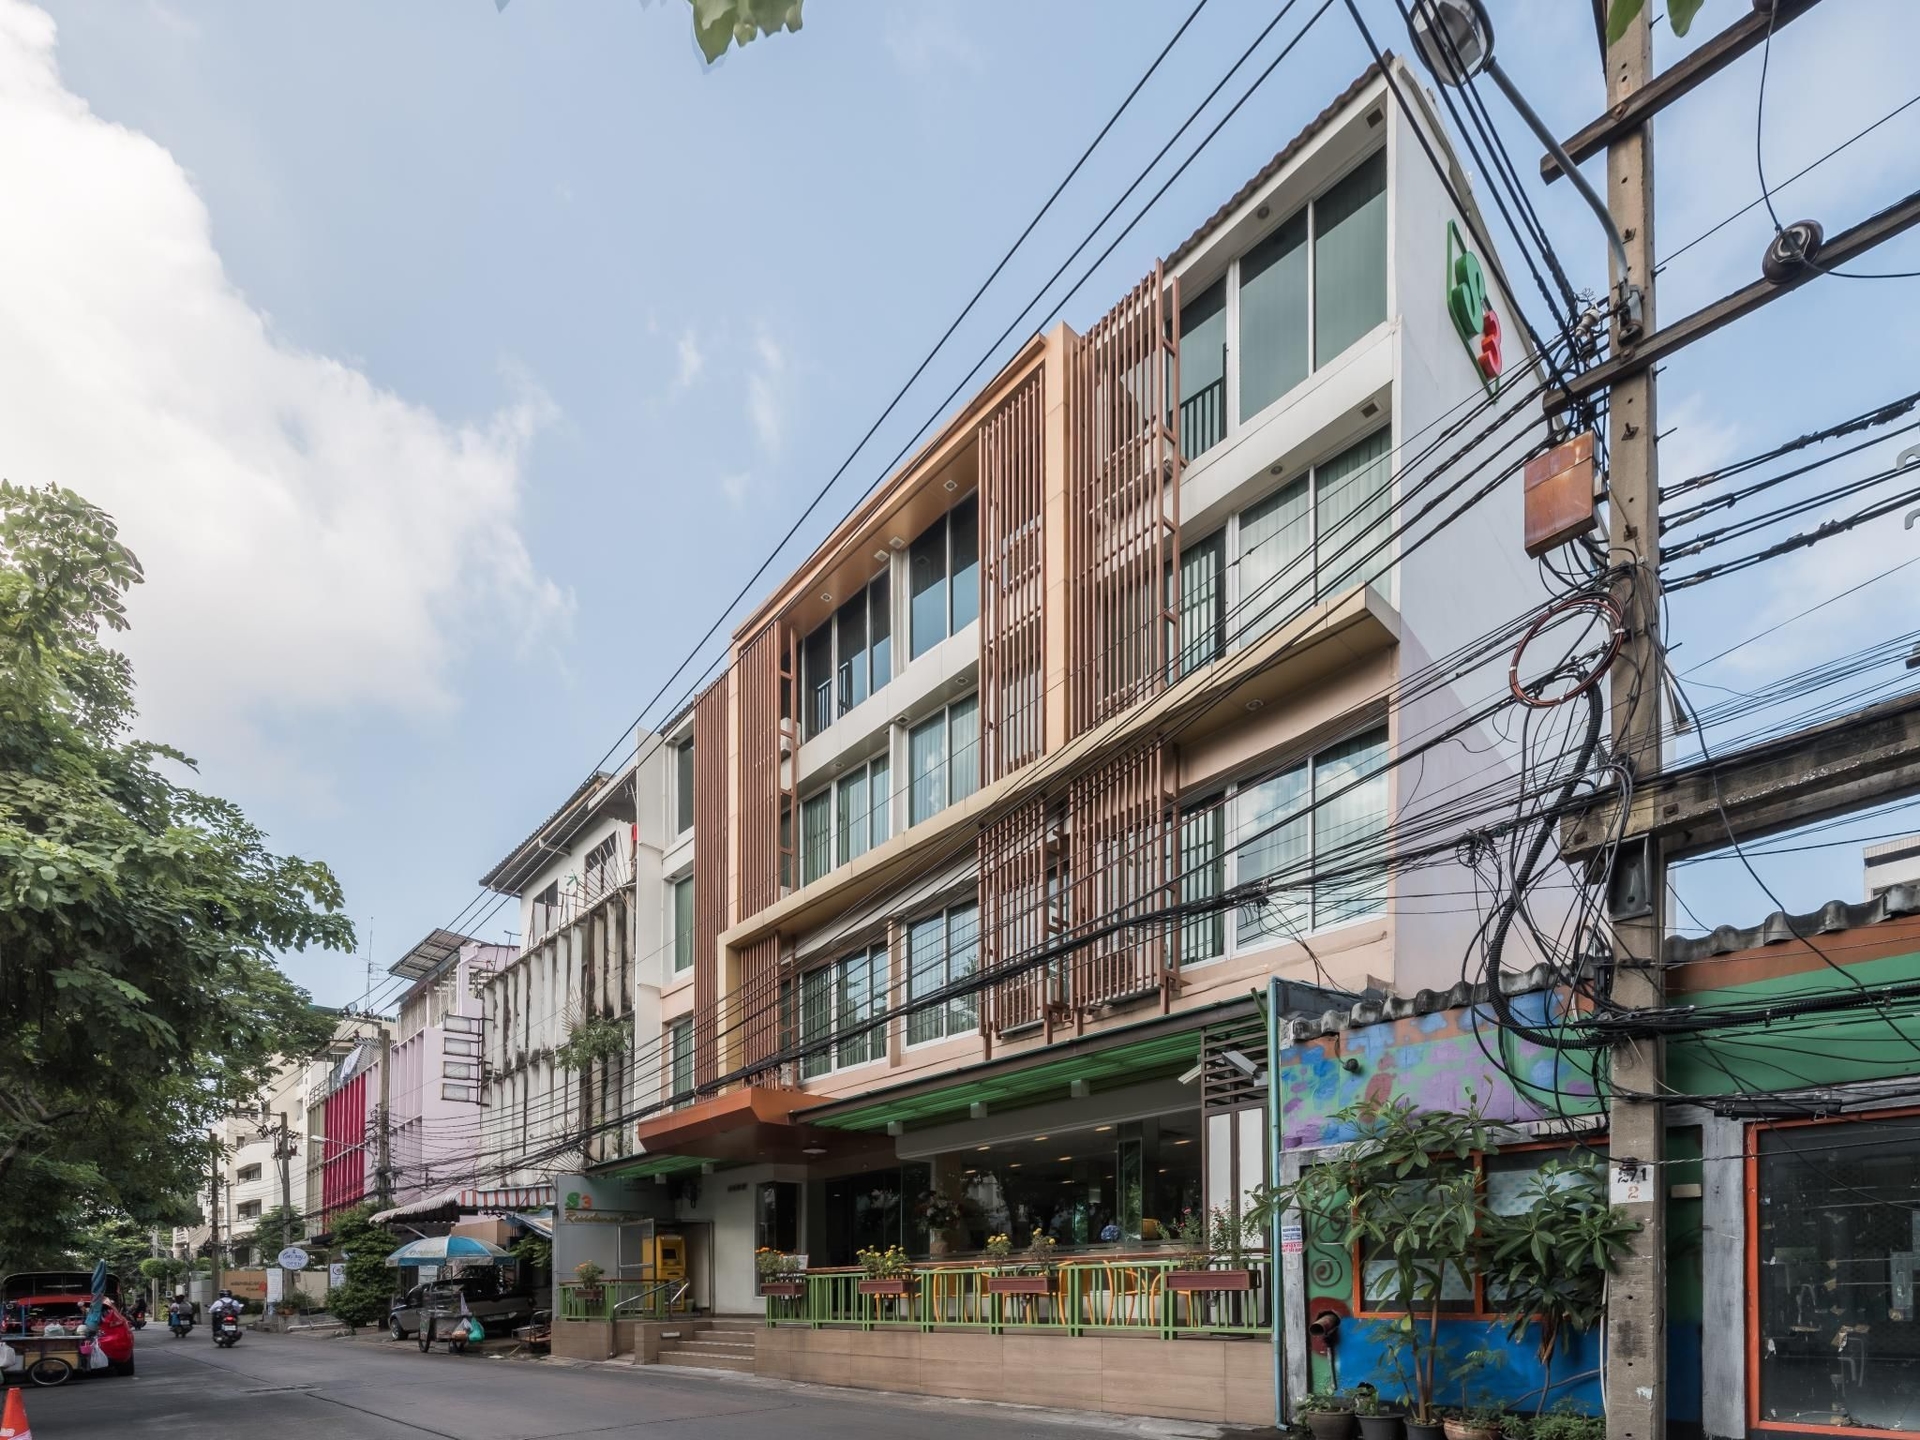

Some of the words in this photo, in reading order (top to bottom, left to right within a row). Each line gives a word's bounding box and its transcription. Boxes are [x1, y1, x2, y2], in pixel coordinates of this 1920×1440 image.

[1451, 251, 1503, 381] S3
[565, 1191, 593, 1210] S3
[1627, 1185, 1640, 1200] 2
